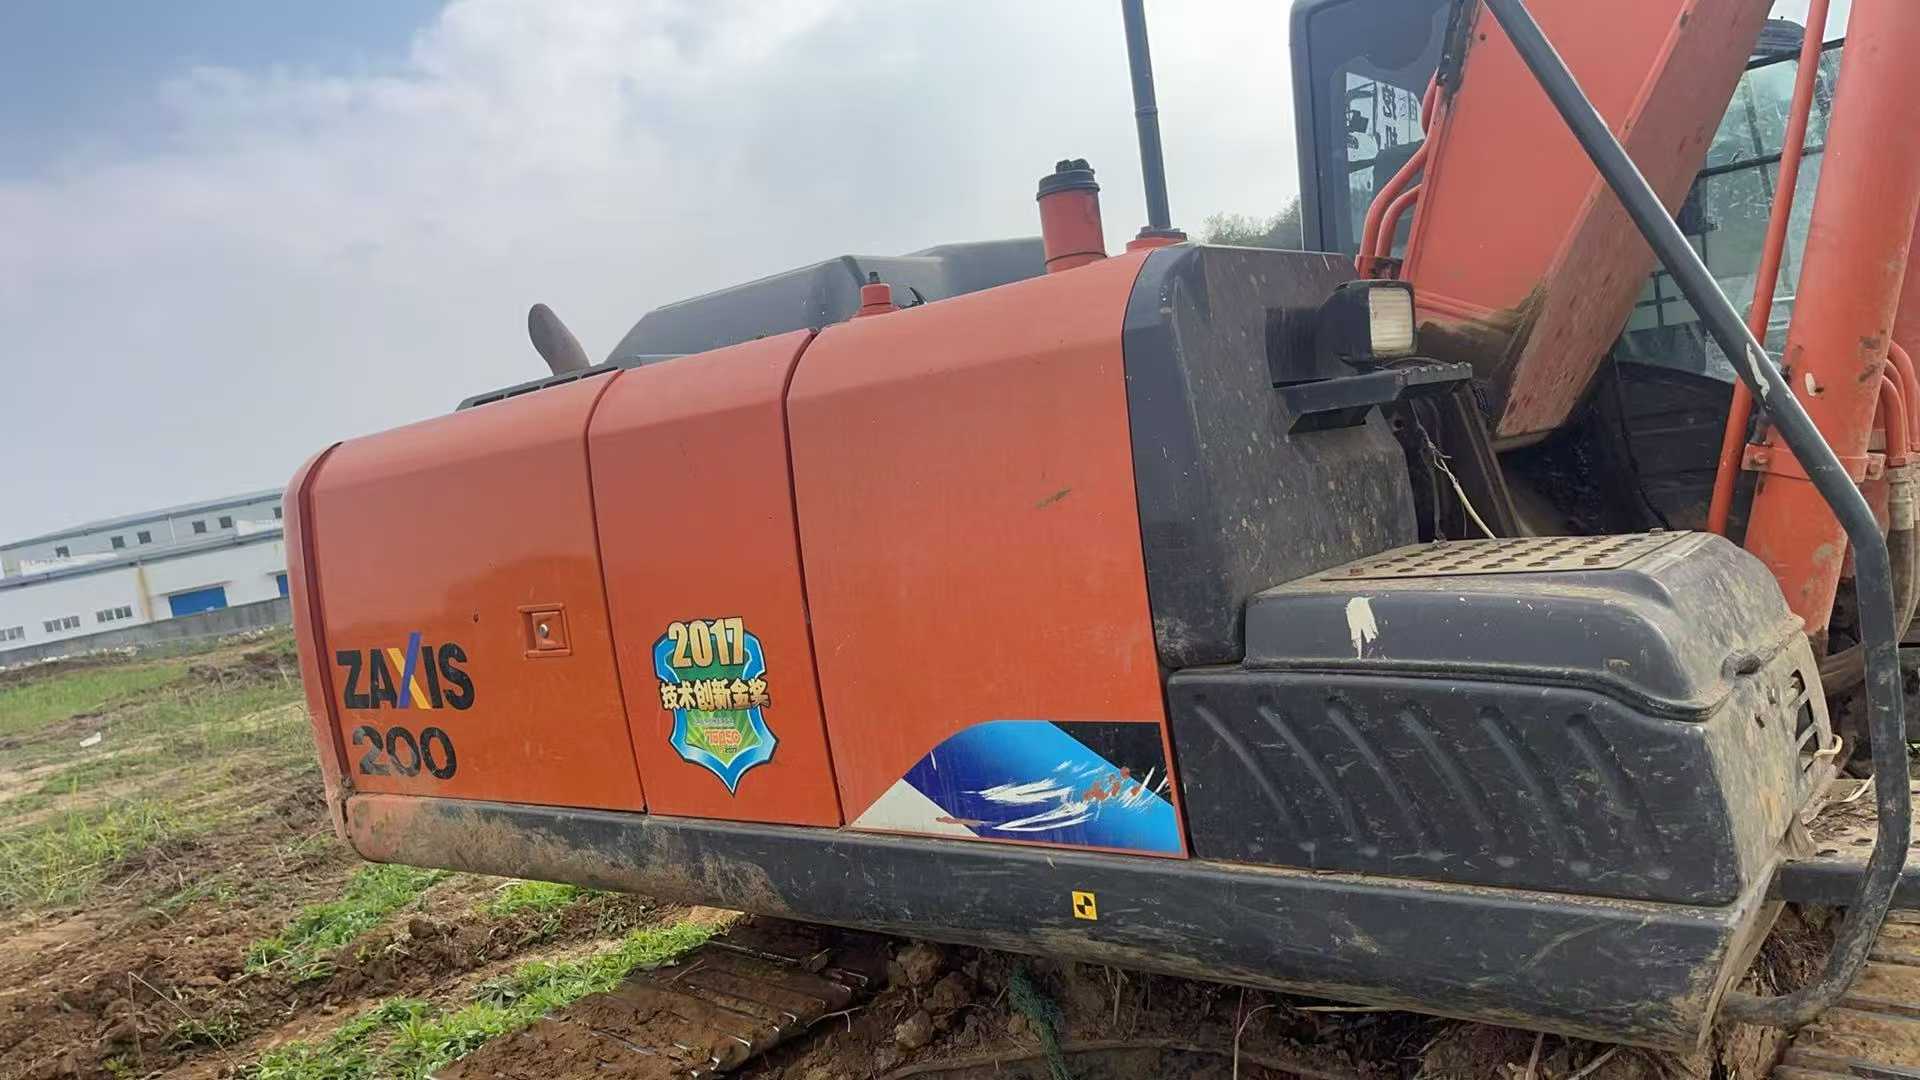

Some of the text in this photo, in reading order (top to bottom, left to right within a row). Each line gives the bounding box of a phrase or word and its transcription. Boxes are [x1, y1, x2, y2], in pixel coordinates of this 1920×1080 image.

[668, 616, 745, 669] 2017
[336, 630, 475, 710] ZAXIS
[660, 677, 770, 713] 技术创新金奖
[352, 725, 457, 780] 200
